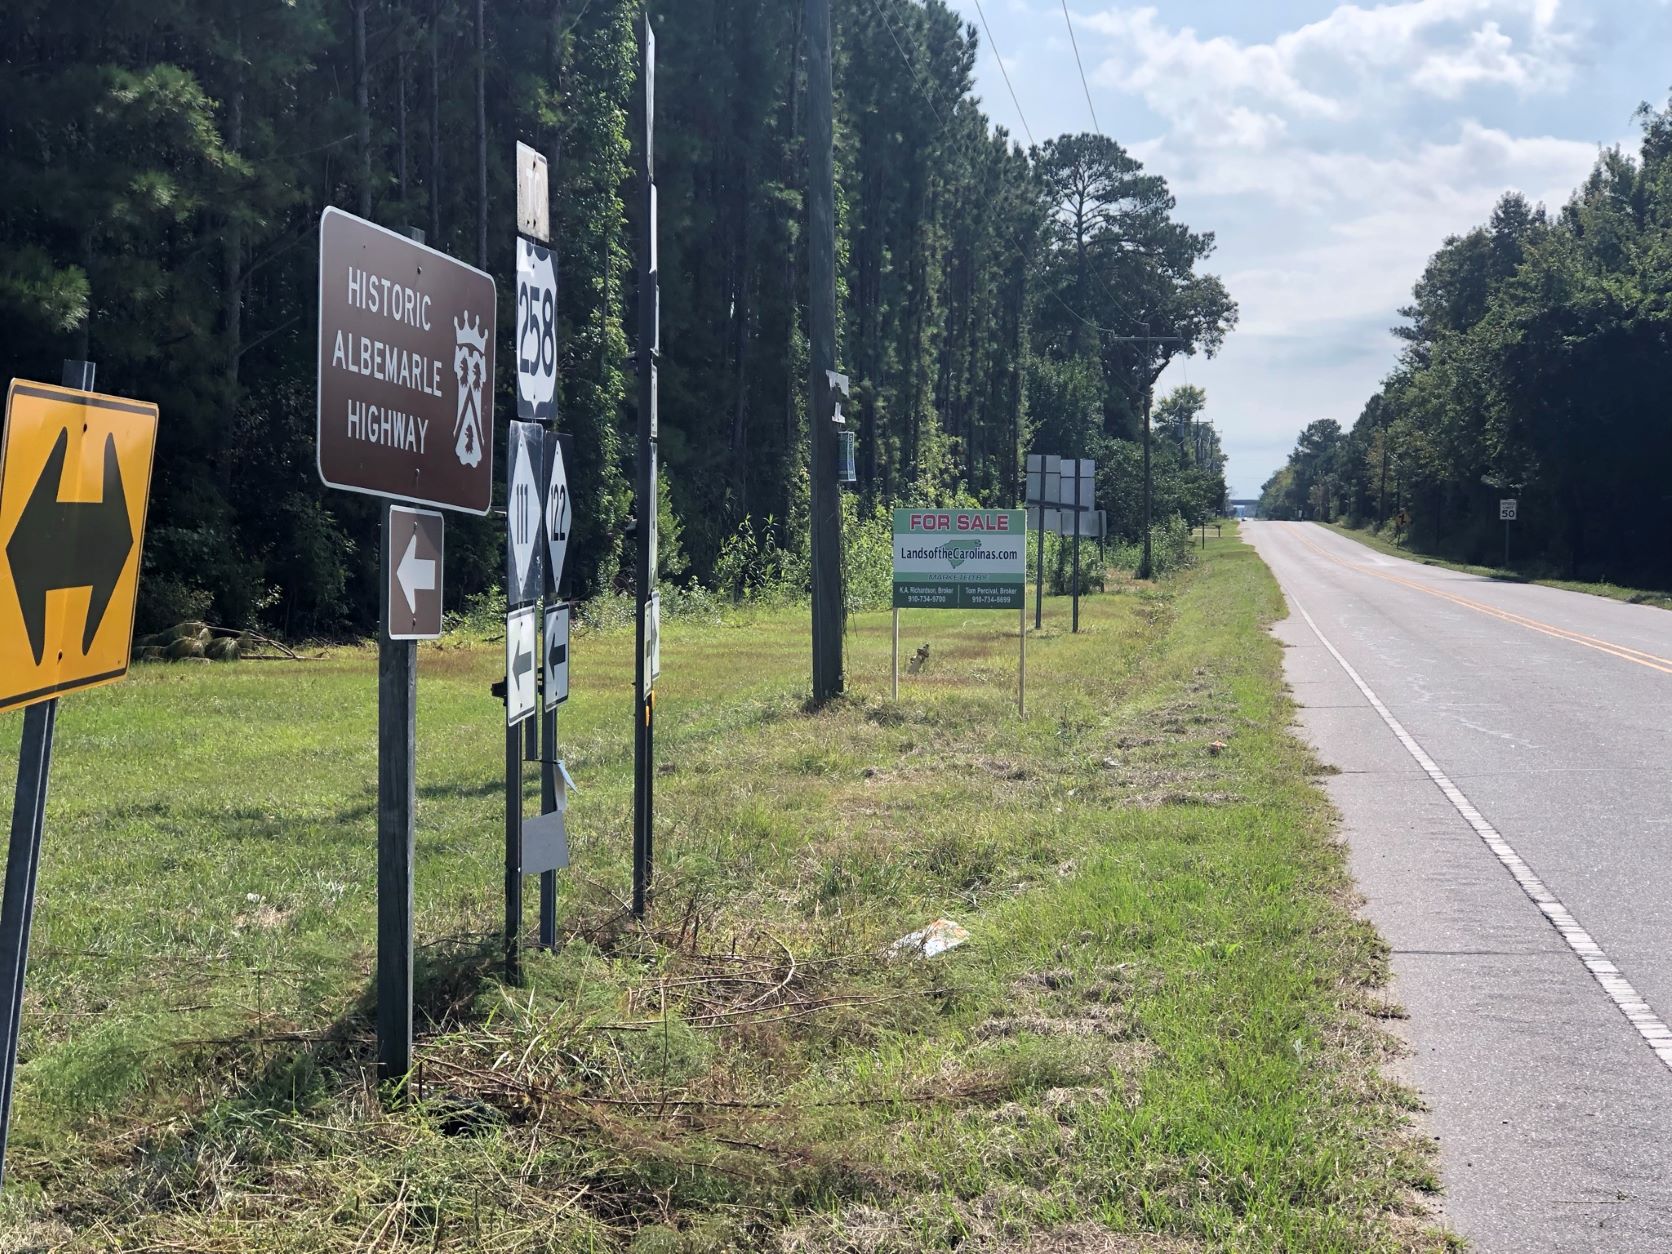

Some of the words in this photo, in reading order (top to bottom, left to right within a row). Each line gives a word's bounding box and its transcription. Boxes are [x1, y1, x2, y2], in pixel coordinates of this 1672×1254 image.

[347, 266, 432, 332] HISTORIC
[519, 281, 555, 378] 258
[332, 329, 442, 397] ALBEMARLE
[347, 399, 429, 454] HIGHWAY
[516, 483, 528, 545] 111
[551, 483, 566, 541] 122
[910, 514, 950, 530] FOR
[957, 514, 1009, 531] SALE
[1502, 510, 1514, 518] 50
[901, 547, 1018, 560] LandsoftheCarolinas.com
